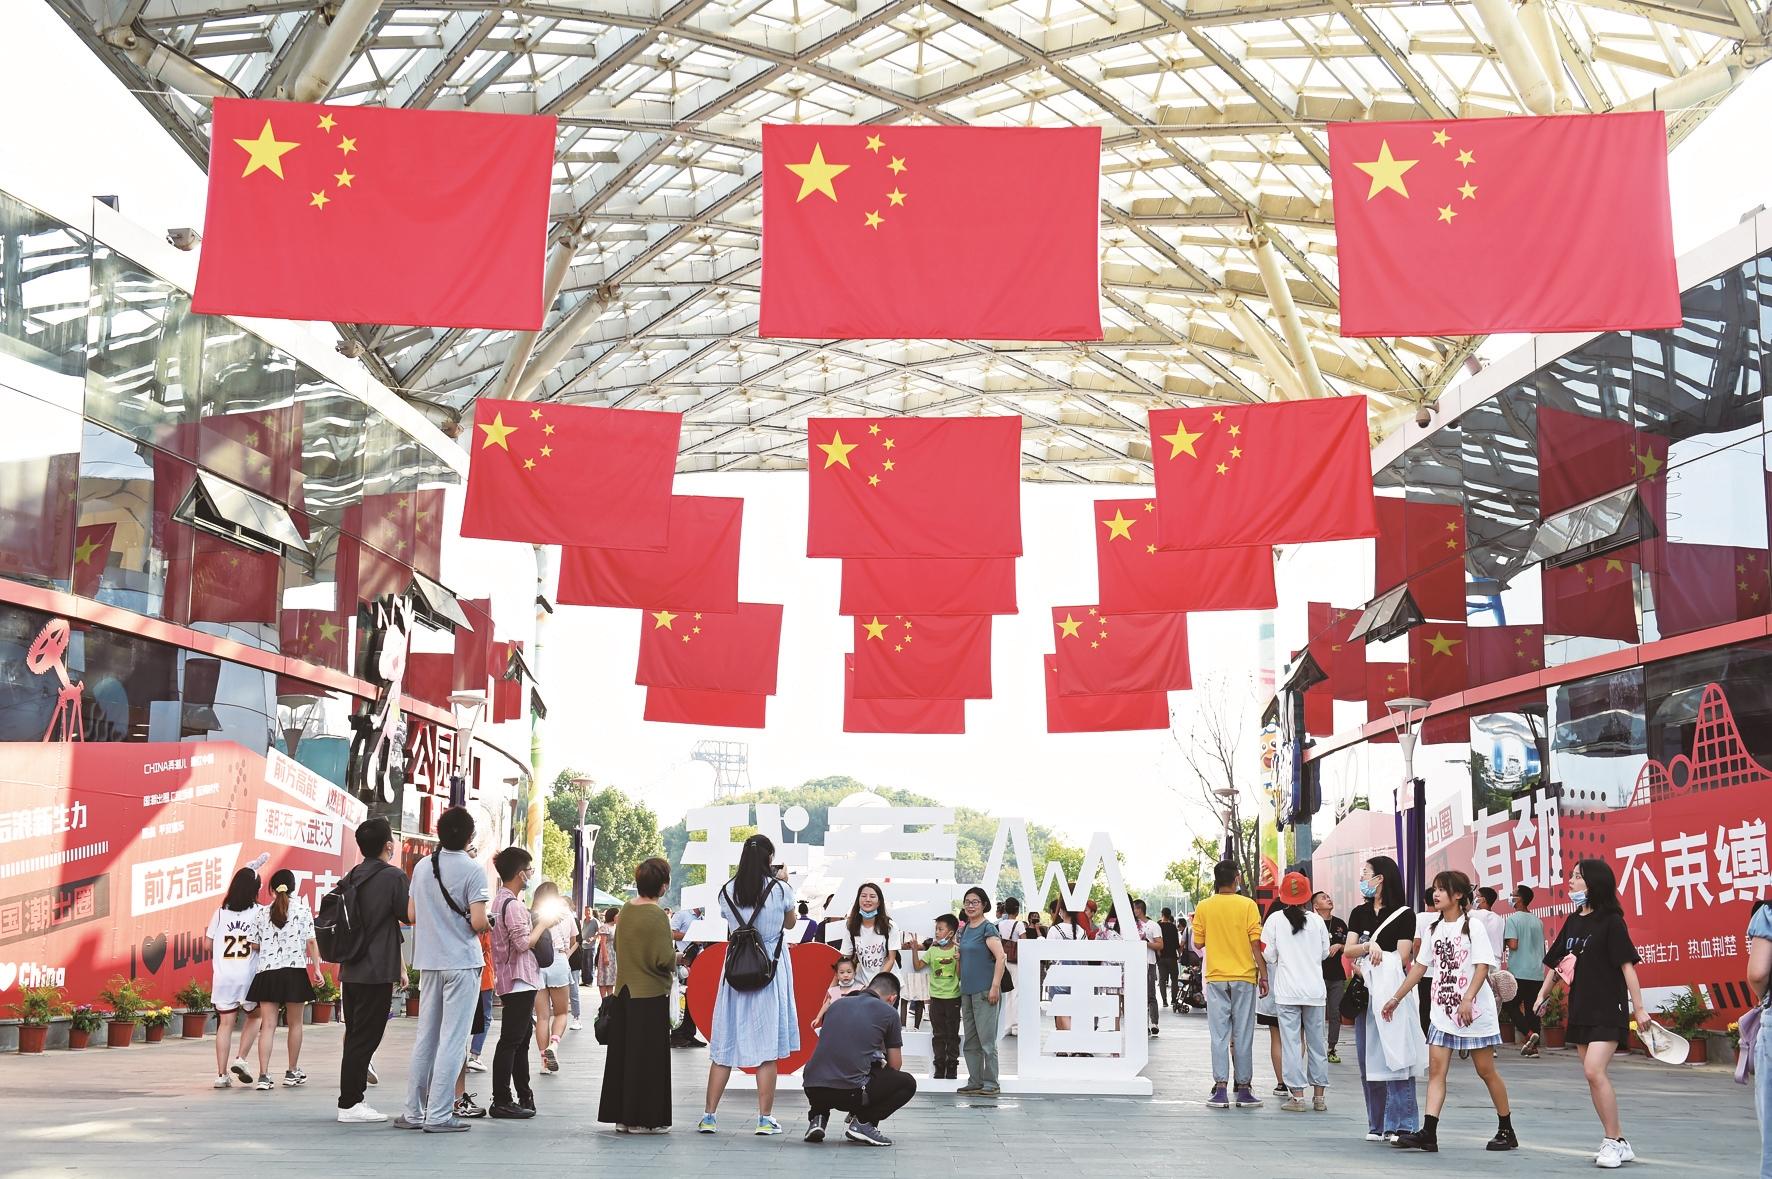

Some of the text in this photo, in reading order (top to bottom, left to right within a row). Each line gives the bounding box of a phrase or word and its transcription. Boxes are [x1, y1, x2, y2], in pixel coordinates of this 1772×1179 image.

[273, 754, 318, 802] 前方高能
[264, 808, 334, 849] 潮流大武汉
[1471, 787, 1563, 901] 有劲
[144, 857, 222, 907] 前方高能
[1615, 817, 1770, 916] 不束缚
[223, 935, 251, 959] 23
[226, 920, 251, 933] JAMES
[1687, 934, 1738, 959] 热血荆楚
[18, 961, 67, 989] China
